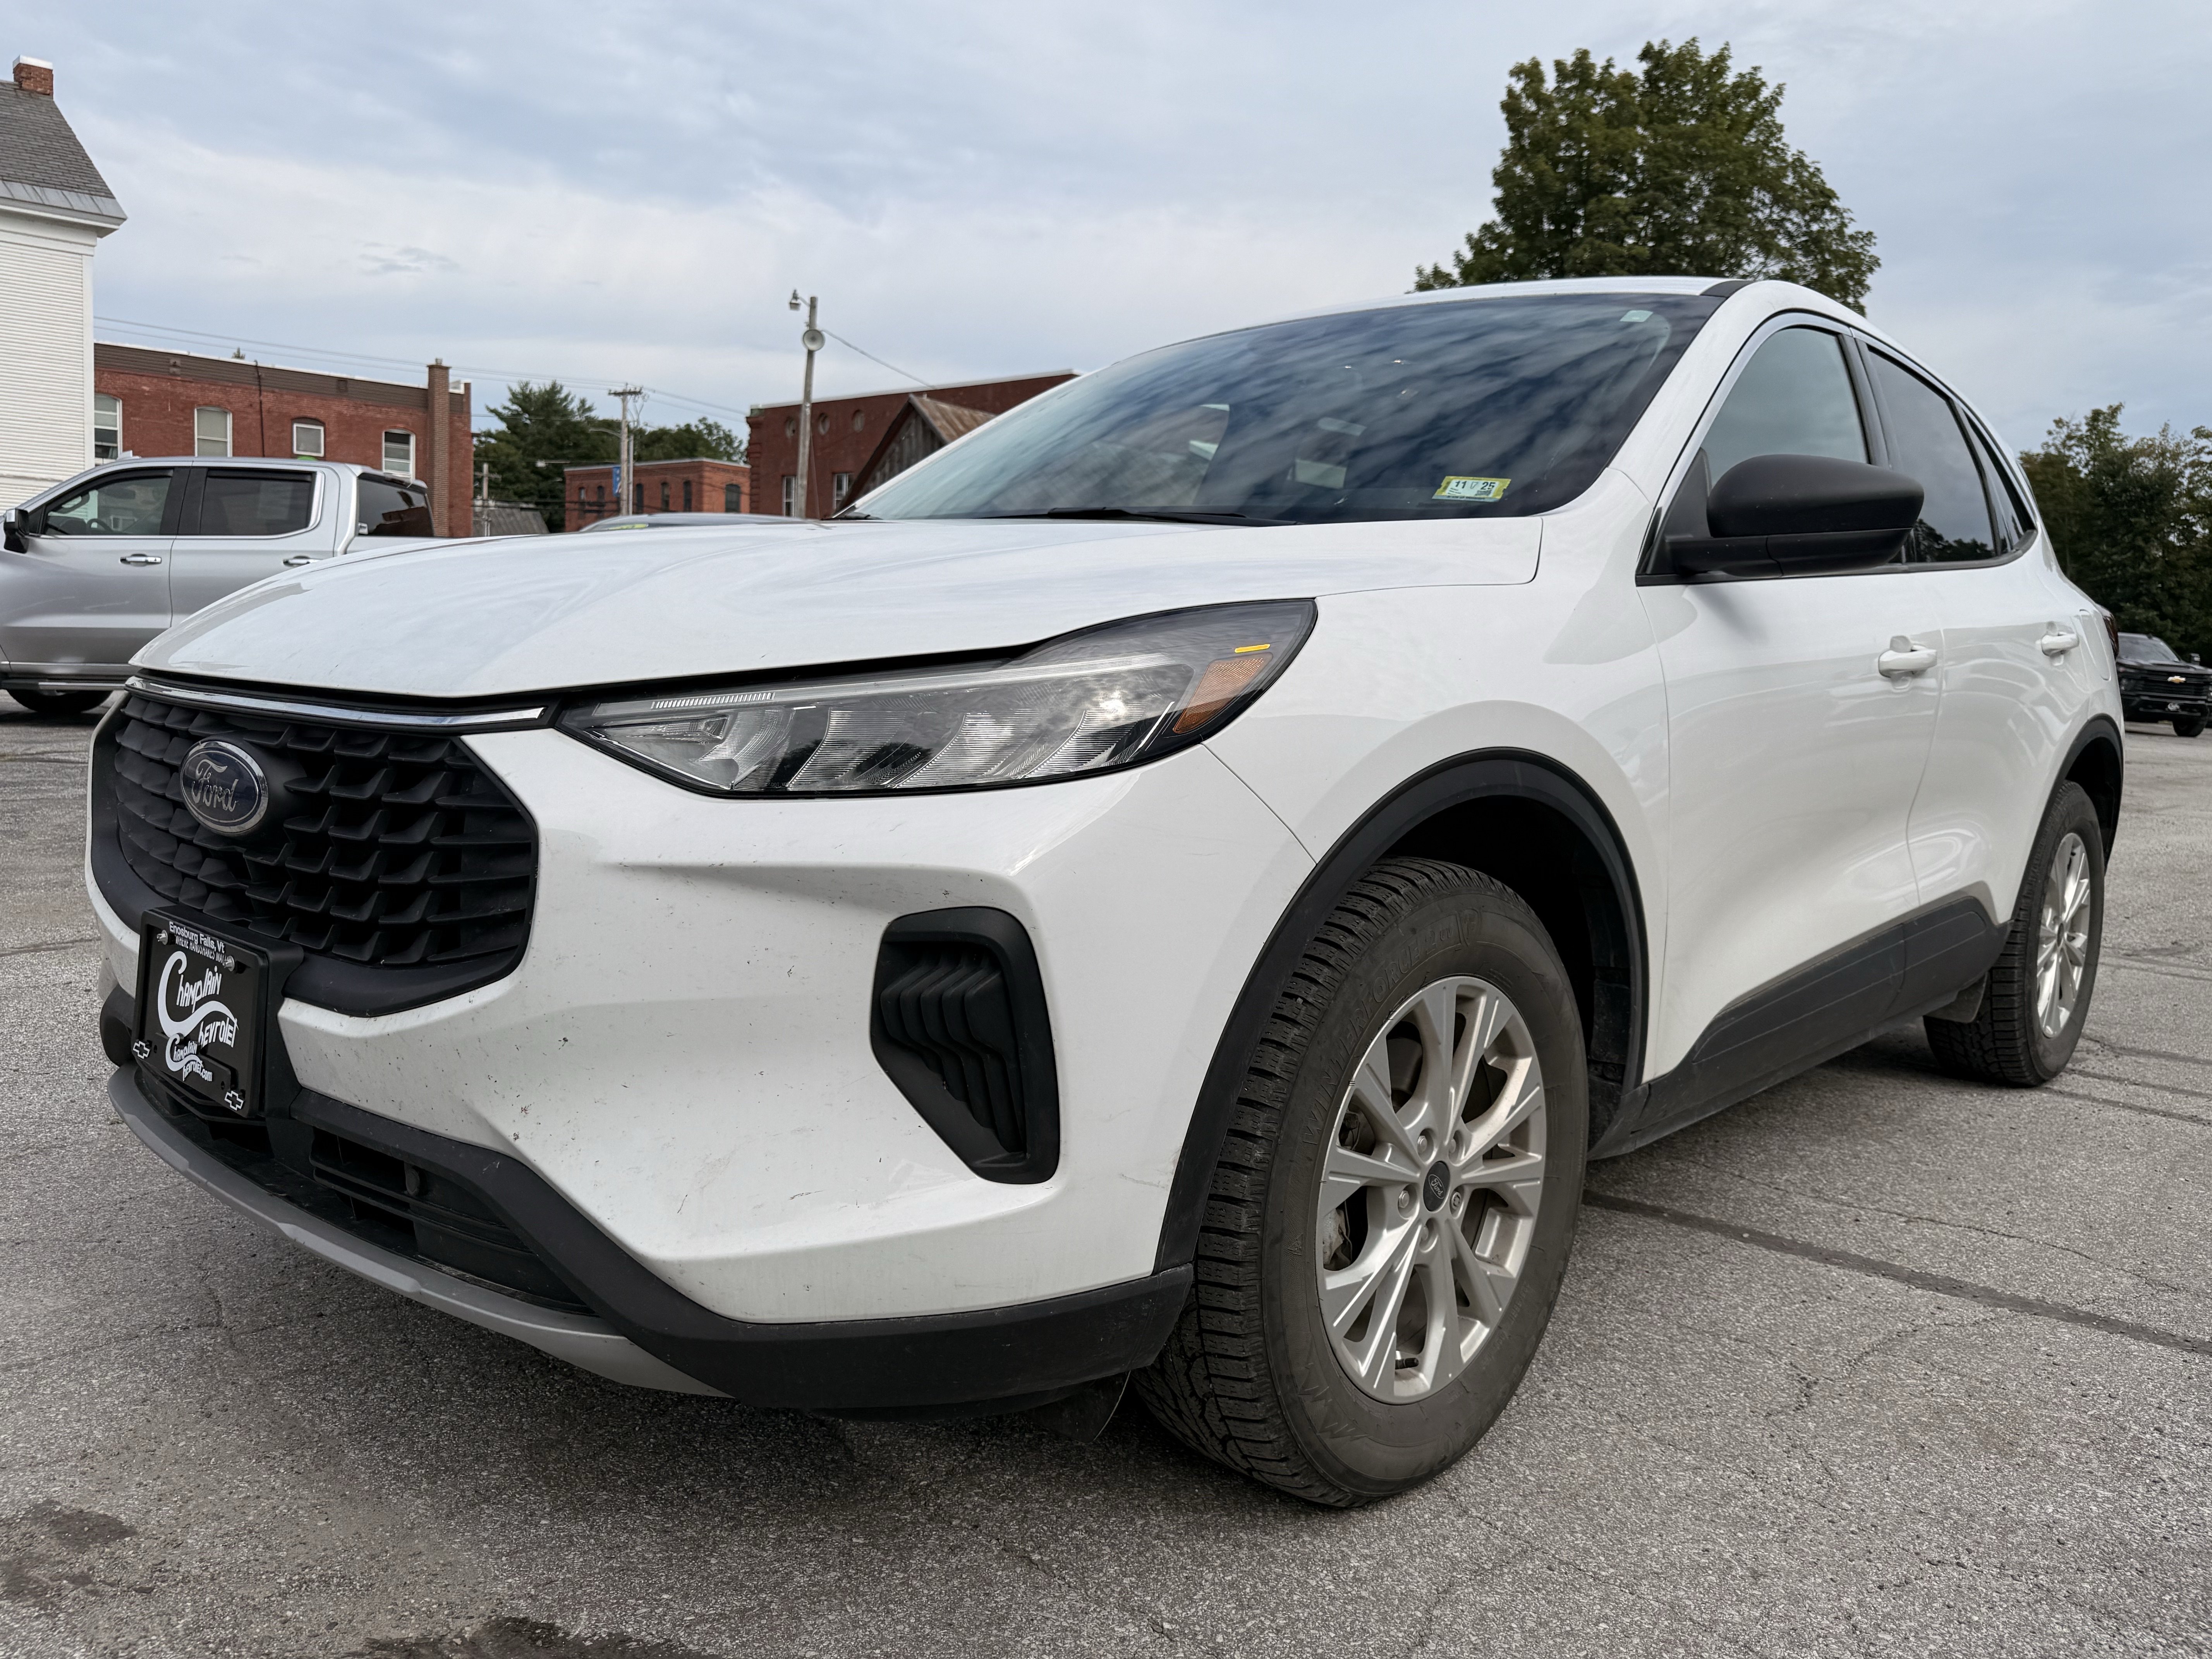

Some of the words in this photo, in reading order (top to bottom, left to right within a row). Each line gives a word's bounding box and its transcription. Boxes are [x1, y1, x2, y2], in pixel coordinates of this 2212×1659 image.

[1455, 481, 1467, 489] 11
[1480, 481, 1496, 490] 25
[192, 759, 239, 812] Ford
[169, 921, 198, 945] Enosburg
[199, 933, 216, 952] Falls,
[217, 940, 225, 953] Vt
[1431, 1178, 1444, 1196] Ford
